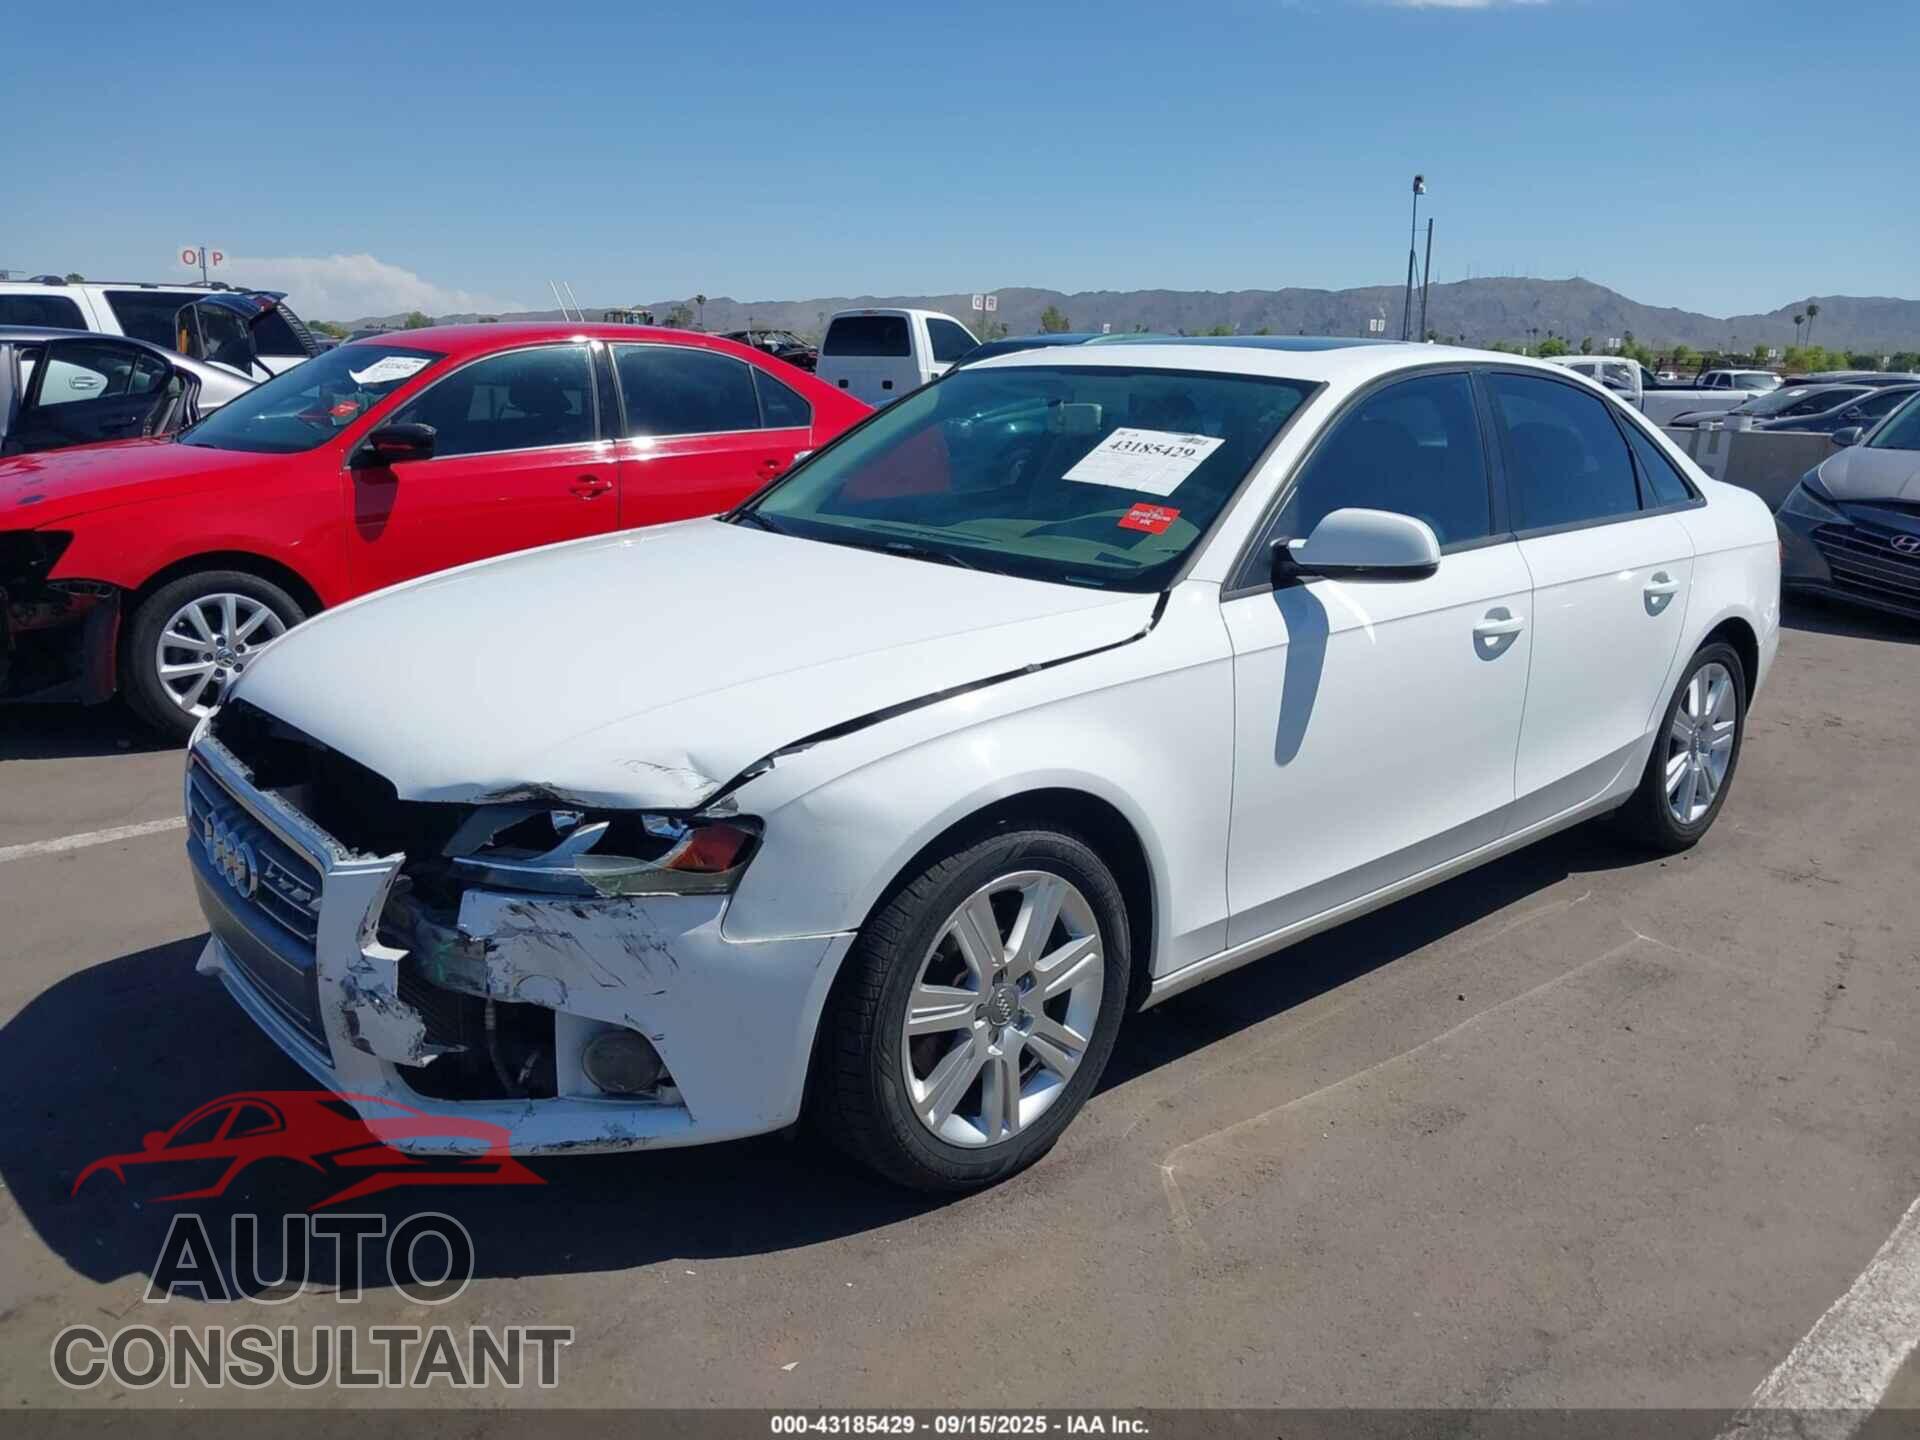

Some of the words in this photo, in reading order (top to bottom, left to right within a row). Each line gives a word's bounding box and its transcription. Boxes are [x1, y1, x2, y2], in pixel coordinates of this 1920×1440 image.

[182, 249, 196, 265] O
[212, 251, 224, 266] P
[1109, 439, 1197, 458] 43185429
